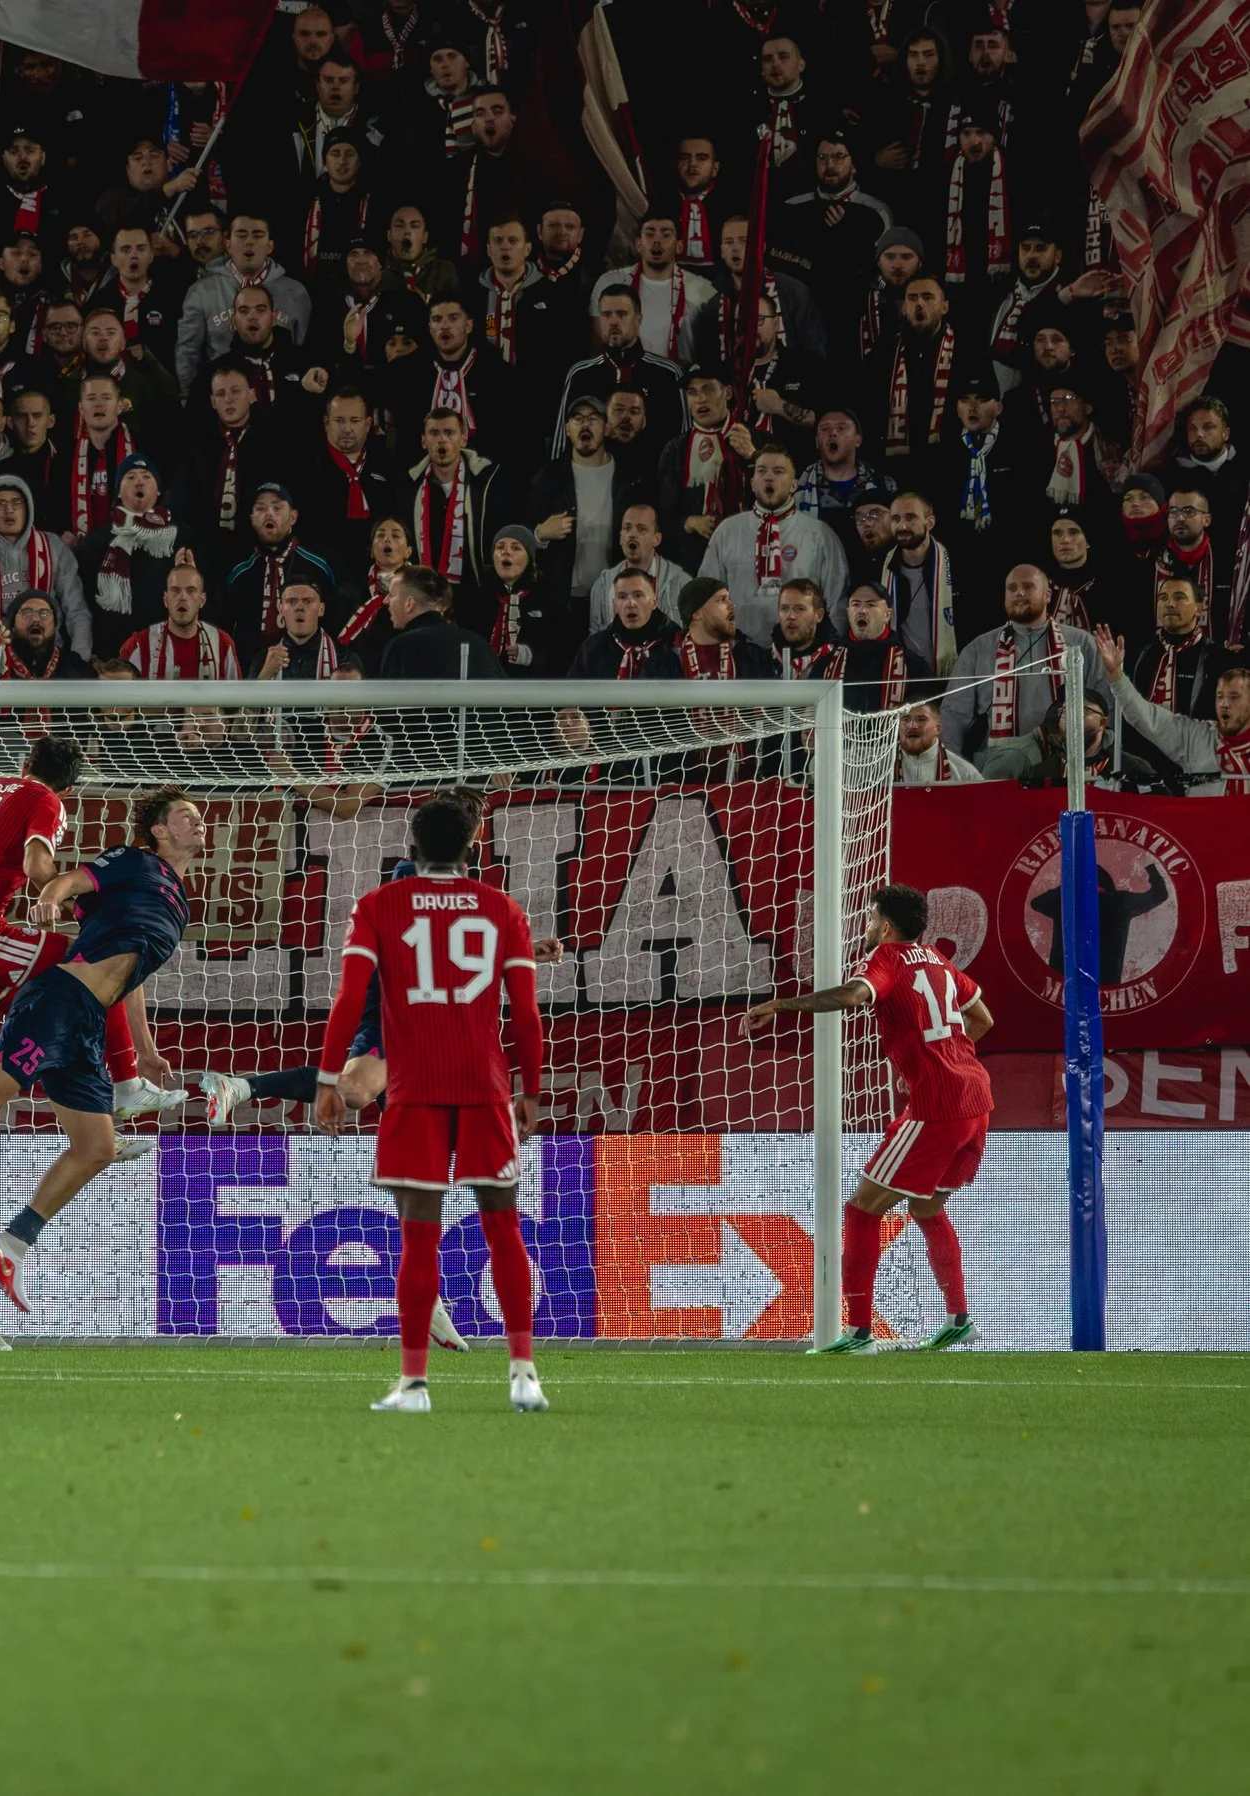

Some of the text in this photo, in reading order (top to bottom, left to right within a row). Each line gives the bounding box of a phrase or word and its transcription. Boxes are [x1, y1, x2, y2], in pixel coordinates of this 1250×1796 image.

[1094, 817, 1191, 876] ANATIC
[411, 892, 479, 911] DAVIES
[401, 915, 499, 1005] 19
[899, 948, 927, 965] LUIS
[912, 968, 967, 1042] 14
[8, 1036, 46, 1077] 25
